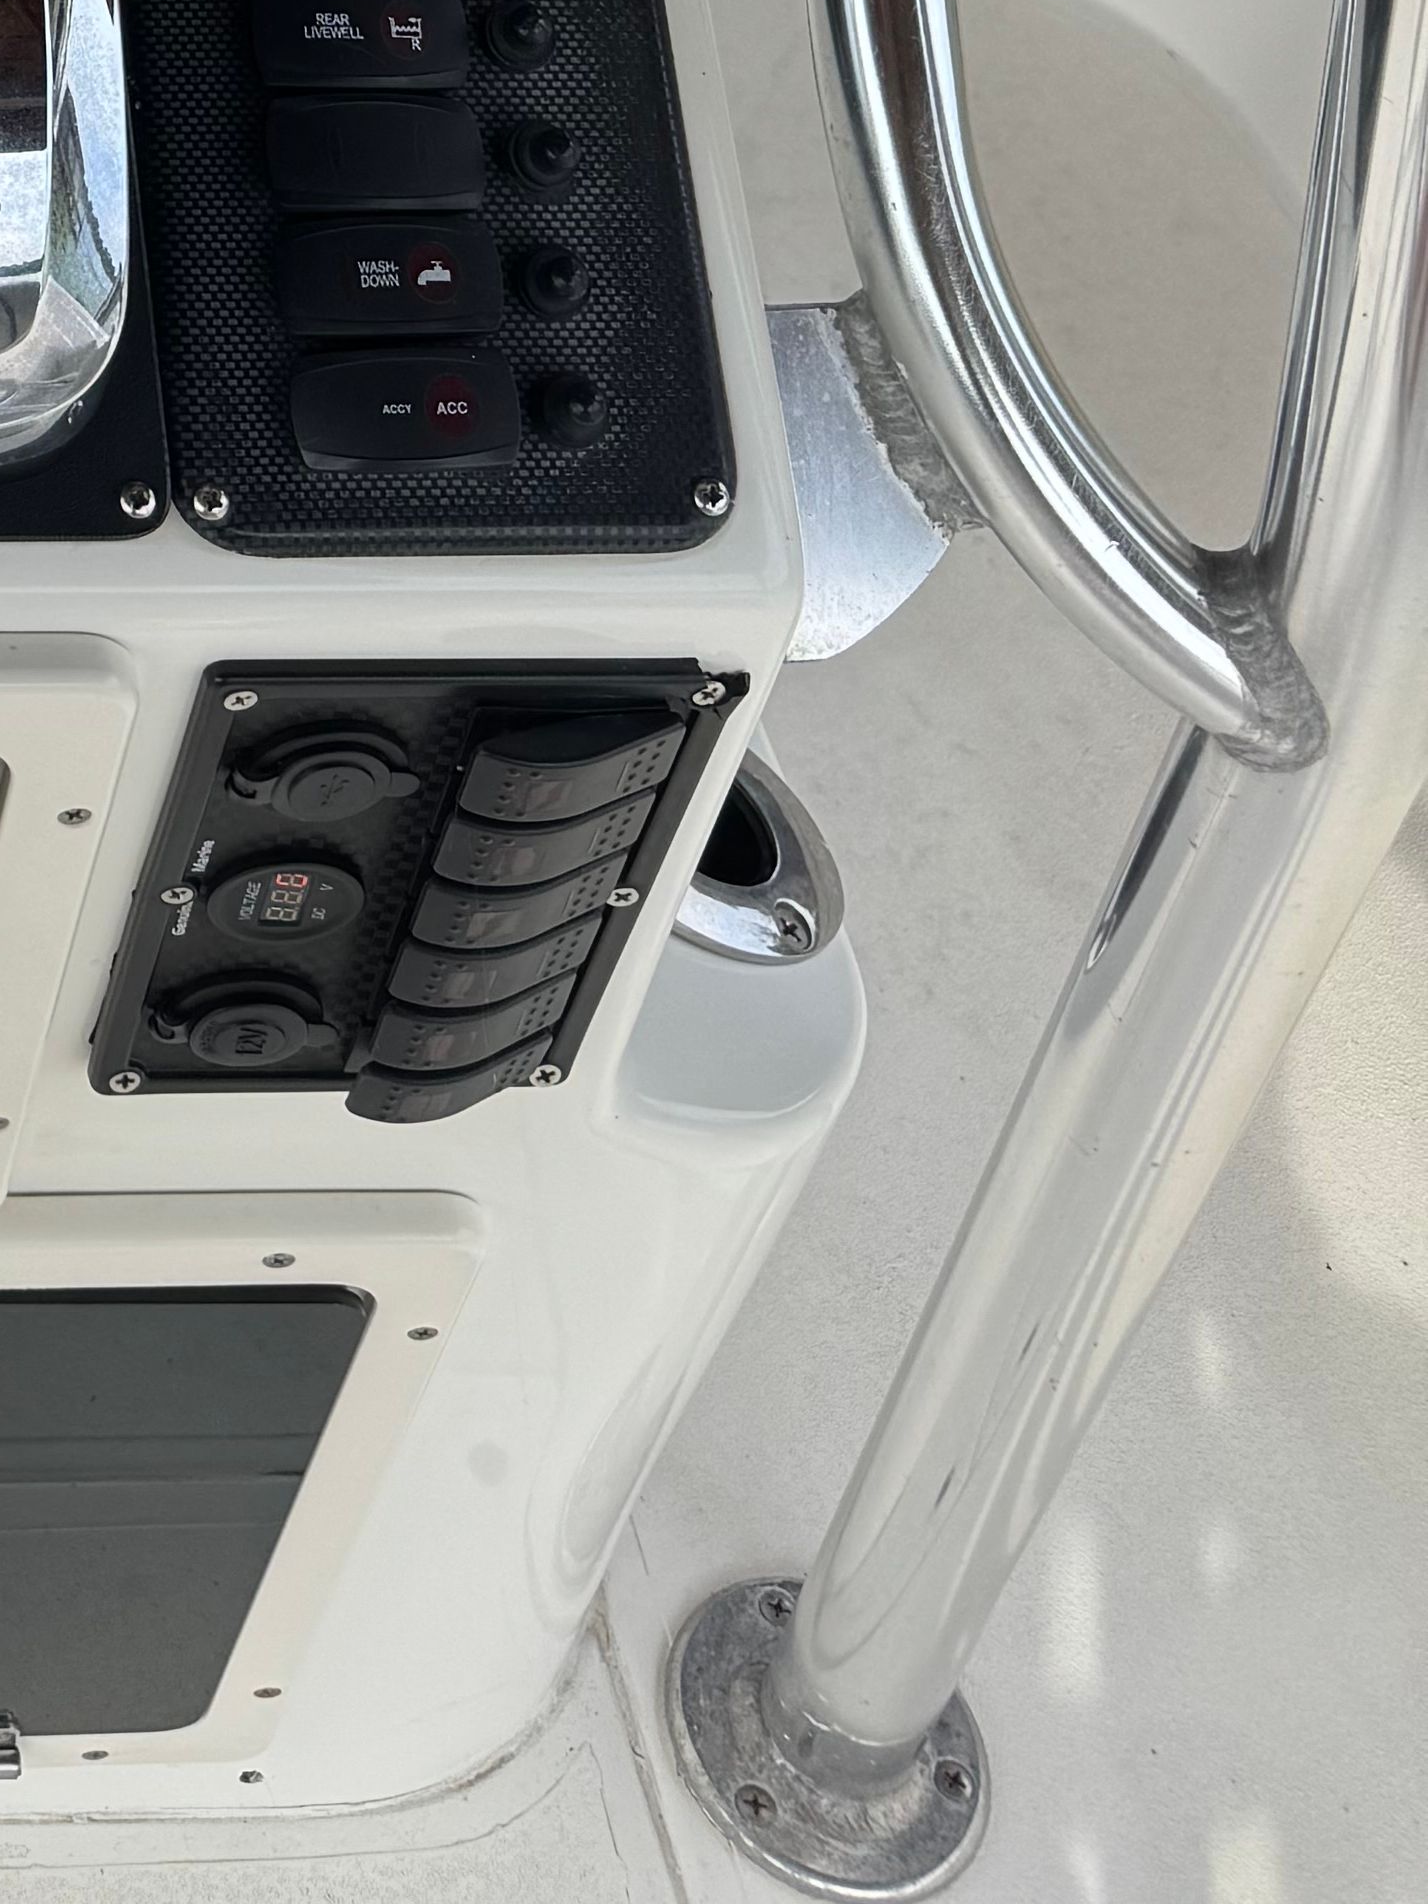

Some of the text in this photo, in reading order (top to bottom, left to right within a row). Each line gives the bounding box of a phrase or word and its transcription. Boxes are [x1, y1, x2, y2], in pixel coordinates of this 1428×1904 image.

[315, 12, 350, 26] REAR
[303, 25, 365, 40] LIVEWELL
[357, 259, 400, 275] WASH-
[360, 273, 401, 289] DOWN
[382, 403, 412, 415] ACCY
[436, 400, 469, 416] ACC
[190, 839, 216, 873] Marine
[237, 880, 262, 922] VOLTAGE
[311, 906, 327, 921] DC
